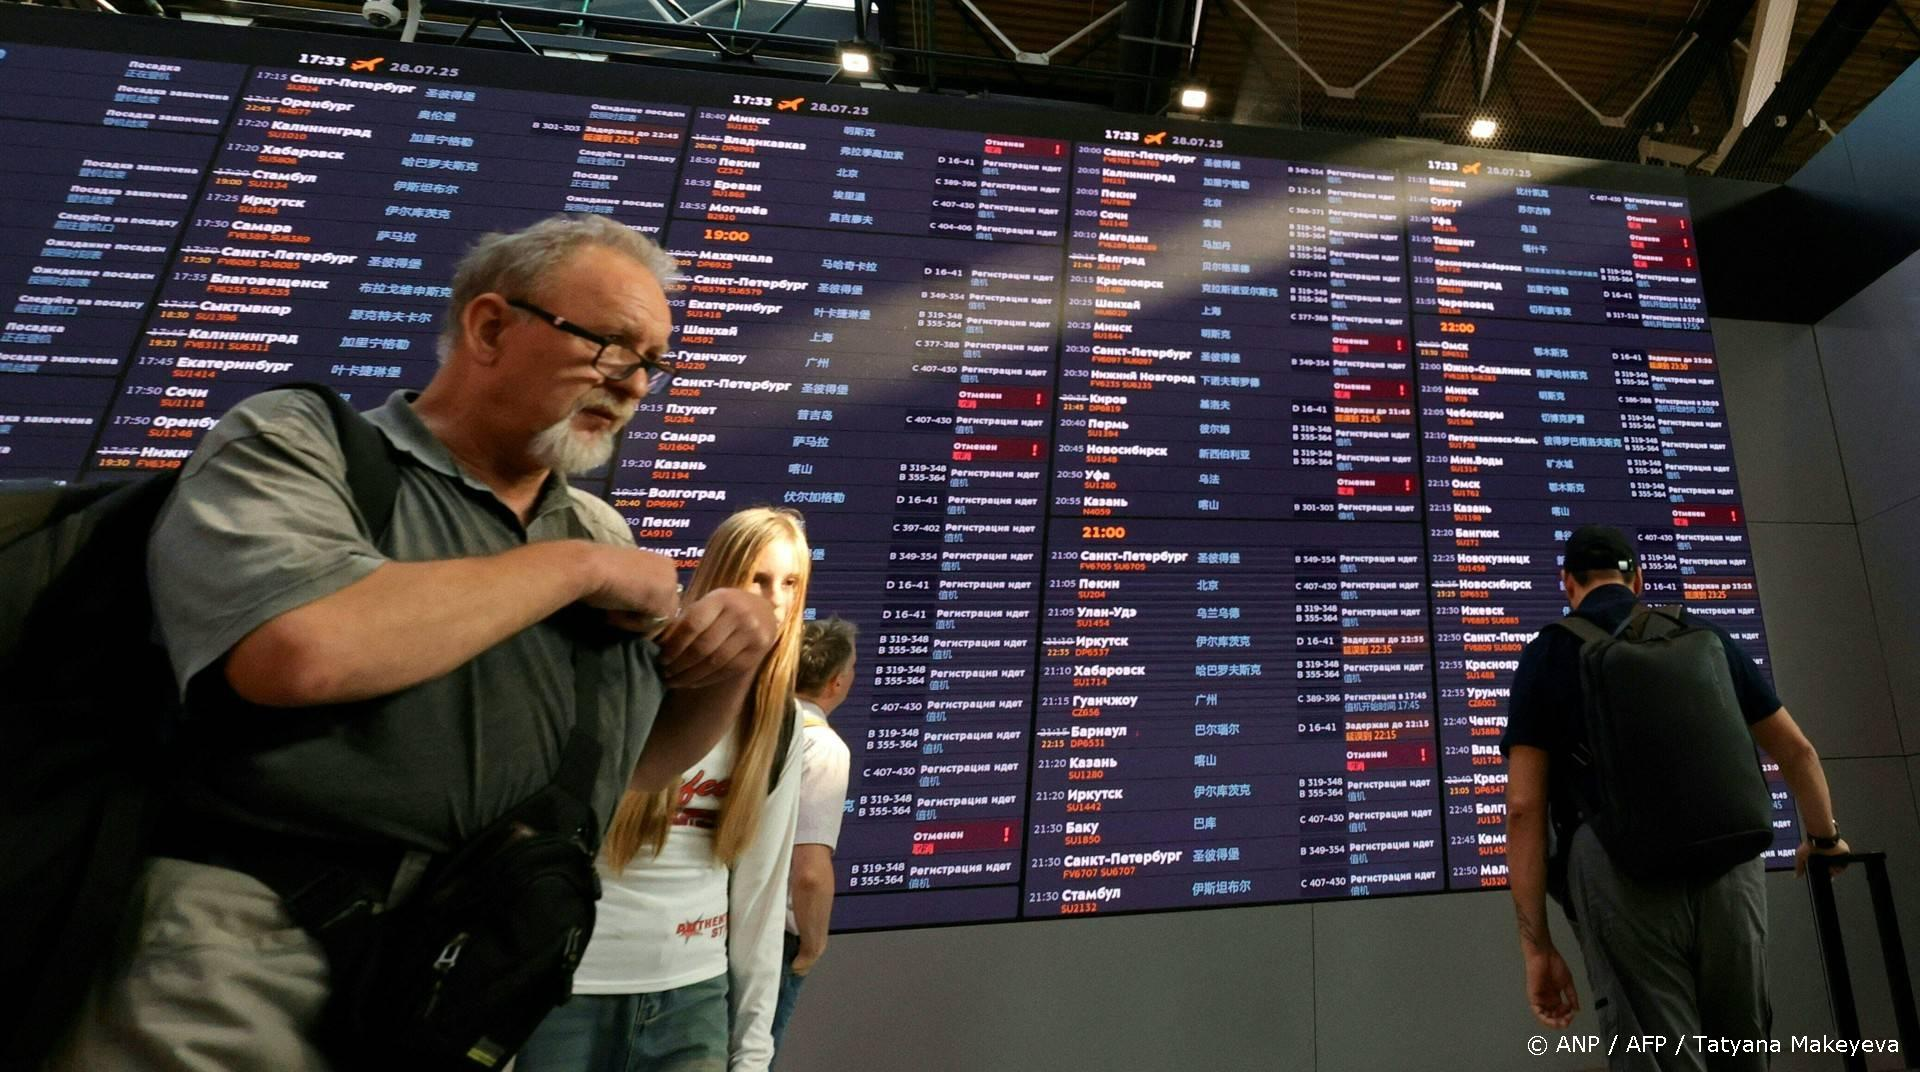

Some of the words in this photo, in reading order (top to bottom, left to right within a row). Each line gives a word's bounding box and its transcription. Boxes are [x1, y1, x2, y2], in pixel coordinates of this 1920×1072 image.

[129, 61, 181, 72] Посадка
[299, 53, 346, 66] 17:33
[389, 62, 459, 77] 28.07.25
[117, 85, 167, 95] Посадка
[290, 74, 417, 94] Санкт-Петербург
[279, 97, 355, 112] Оренбург
[733, 95, 773, 106] 17:33
[810, 102, 869, 115] 28.07.25
[106, 109, 156, 119] Посадка
[728, 114, 771, 125] Минск
[271, 121, 372, 138] Калининград
[722, 135, 807, 150] Владикавказ
[1105, 130, 1139, 141] 17:33
[1172, 136, 1223, 148] 28.07.25
[260, 145, 345, 160] Хабаровск
[1103, 148, 1197, 164] Санкт-Петербург
[82, 159, 134, 169] Посадка
[718, 157, 760, 169] Пекин
[250, 170, 318, 184] Стамбул
[1102, 168, 1176, 183] Калининград
[714, 180, 762, 192] Ереван
[1101, 189, 1137, 200] Пекин
[241, 195, 306, 208] Иркутск
[1100, 210, 1128, 220] Сочи
[195, 219, 229, 228] 17:30
[231, 220, 292, 234] Самара
[704, 229, 750, 242] 19:00
[1098, 232, 1149, 243] Магадан
[220, 247, 358, 265] Санкт-Петербург
[698, 250, 773, 263] Махачкала
[1097, 254, 1146, 266] Белград
[173, 272, 207, 281] 17:35
[210, 273, 330, 289] Благовещенск
[692, 275, 809, 291] Санкт-Петербург
[1096, 276, 1164, 289] Красноярск
[198, 301, 292, 316] Сыктывкар
[688, 299, 783, 315] Екатеринбург
[1095, 299, 1141, 310] Шанхай
[5, 322, 65, 333] Посадка
[683, 325, 738, 336] Шанхай
[1093, 322, 1132, 333] Минск
[1440, 322, 1475, 333] 22:00
[186, 328, 299, 344] Калининград
[1440, 341, 1469, 351] Омск
[677, 350, 747, 364] Гуанчжоу
[1092, 345, 1192, 360] Санкт-Петербург
[138, 356, 174, 366] 17:45
[176, 357, 294, 373] Екатеринбург
[1443, 363, 1531, 376] Южно-Сахалинск
[1091, 370, 1137, 380] Нижний
[1140, 372, 1196, 384] Новгород
[672, 377, 792, 392] Санкт-Петербург
[126, 386, 163, 395] 17:50
[165, 386, 209, 398] Сочи
[1445, 386, 1479, 396] Минск
[1089, 394, 1127, 405] Киров
[666, 404, 717, 416] Пхукет
[1445, 408, 1504, 421] Чебоксары
[114, 416, 151, 425] 17:50
[153, 416, 221, 430] Оренбу
[1060, 419, 1086, 427] 20:40
[1088, 419, 1129, 431] Пермь
[628, 431, 658, 440] 19:20
[660, 431, 716, 444] Самара
[1059, 444, 1084, 453] 20:45
[1086, 444, 1168, 457] Новосибирск
[621, 459, 652, 468] 19:20
[654, 459, 707, 470] Казань
[1450, 455, 1503, 467] Мин.Воды
[1057, 470, 1083, 479] 20:50
[1085, 470, 1110, 482] Уфа
[1451, 479, 1481, 489] Омск
[648, 488, 726, 501] Волгоград
[1055, 497, 1081, 505] 20:55
[1084, 496, 1128, 507] Казань
[1453, 503, 1492, 513] Казань
[642, 517, 690, 528] Пекин
[1083, 526, 1125, 538] 21:00
[1455, 528, 1500, 538] Бангкок
[1051, 551, 1078, 559] 21:00
[1080, 551, 1188, 563] Санкт-Петербург
[1457, 553, 1530, 565] Новокузнецк
[1049, 579, 1076, 588] 21:05
[1079, 578, 1120, 589] Пекин
[1458, 579, 1532, 591] Новосибирск
[1048, 608, 1074, 616] 21:05
[1077, 607, 1137, 619] Улан-Удэ
[1461, 606, 1504, 615] Ижевск
[1076, 636, 1129, 649] Иркутск
[930, 670, 998, 679] Регистрация
[1044, 667, 1072, 675] 21:10
[1073, 665, 1145, 678] Хабаровск
[1442, 689, 1465, 697] 22:35
[1466, 687, 1510, 699] Урумчи
[927, 700, 996, 710] Регистрация
[1042, 697, 1069, 706] 21:15
[1073, 695, 1138, 708] Гуанчжоу
[1443, 717, 1467, 726] 22:40
[1071, 726, 1127, 739] Барнаул
[1346, 751, 1388, 759] Отменен
[1445, 746, 1469, 755] 22:40
[1038, 759, 1067, 768] 21:20
[1069, 757, 1118, 769] Казань
[1036, 791, 1065, 801] 21:20
[1068, 789, 1123, 803] Иркутск
[1449, 805, 1473, 814] 22:45
[1034, 824, 1063, 834] 21:30
[1066, 822, 1099, 835] Баку
[913, 831, 964, 841] Отменен
[1451, 835, 1475, 845] 22:45
[1032, 857, 1061, 868] 21:30
[1064, 850, 1183, 867] Санкт-Петербург
[910, 864, 982, 876] Регистрация
[986, 862, 1012, 872] идет
[1453, 866, 1478, 876] 22:50
[1350, 872, 1411, 884] Регистрация
[1414, 871, 1436, 880] идет
[1029, 891, 1059, 903] 21:30
[1062, 886, 1121, 902] Стамбул
